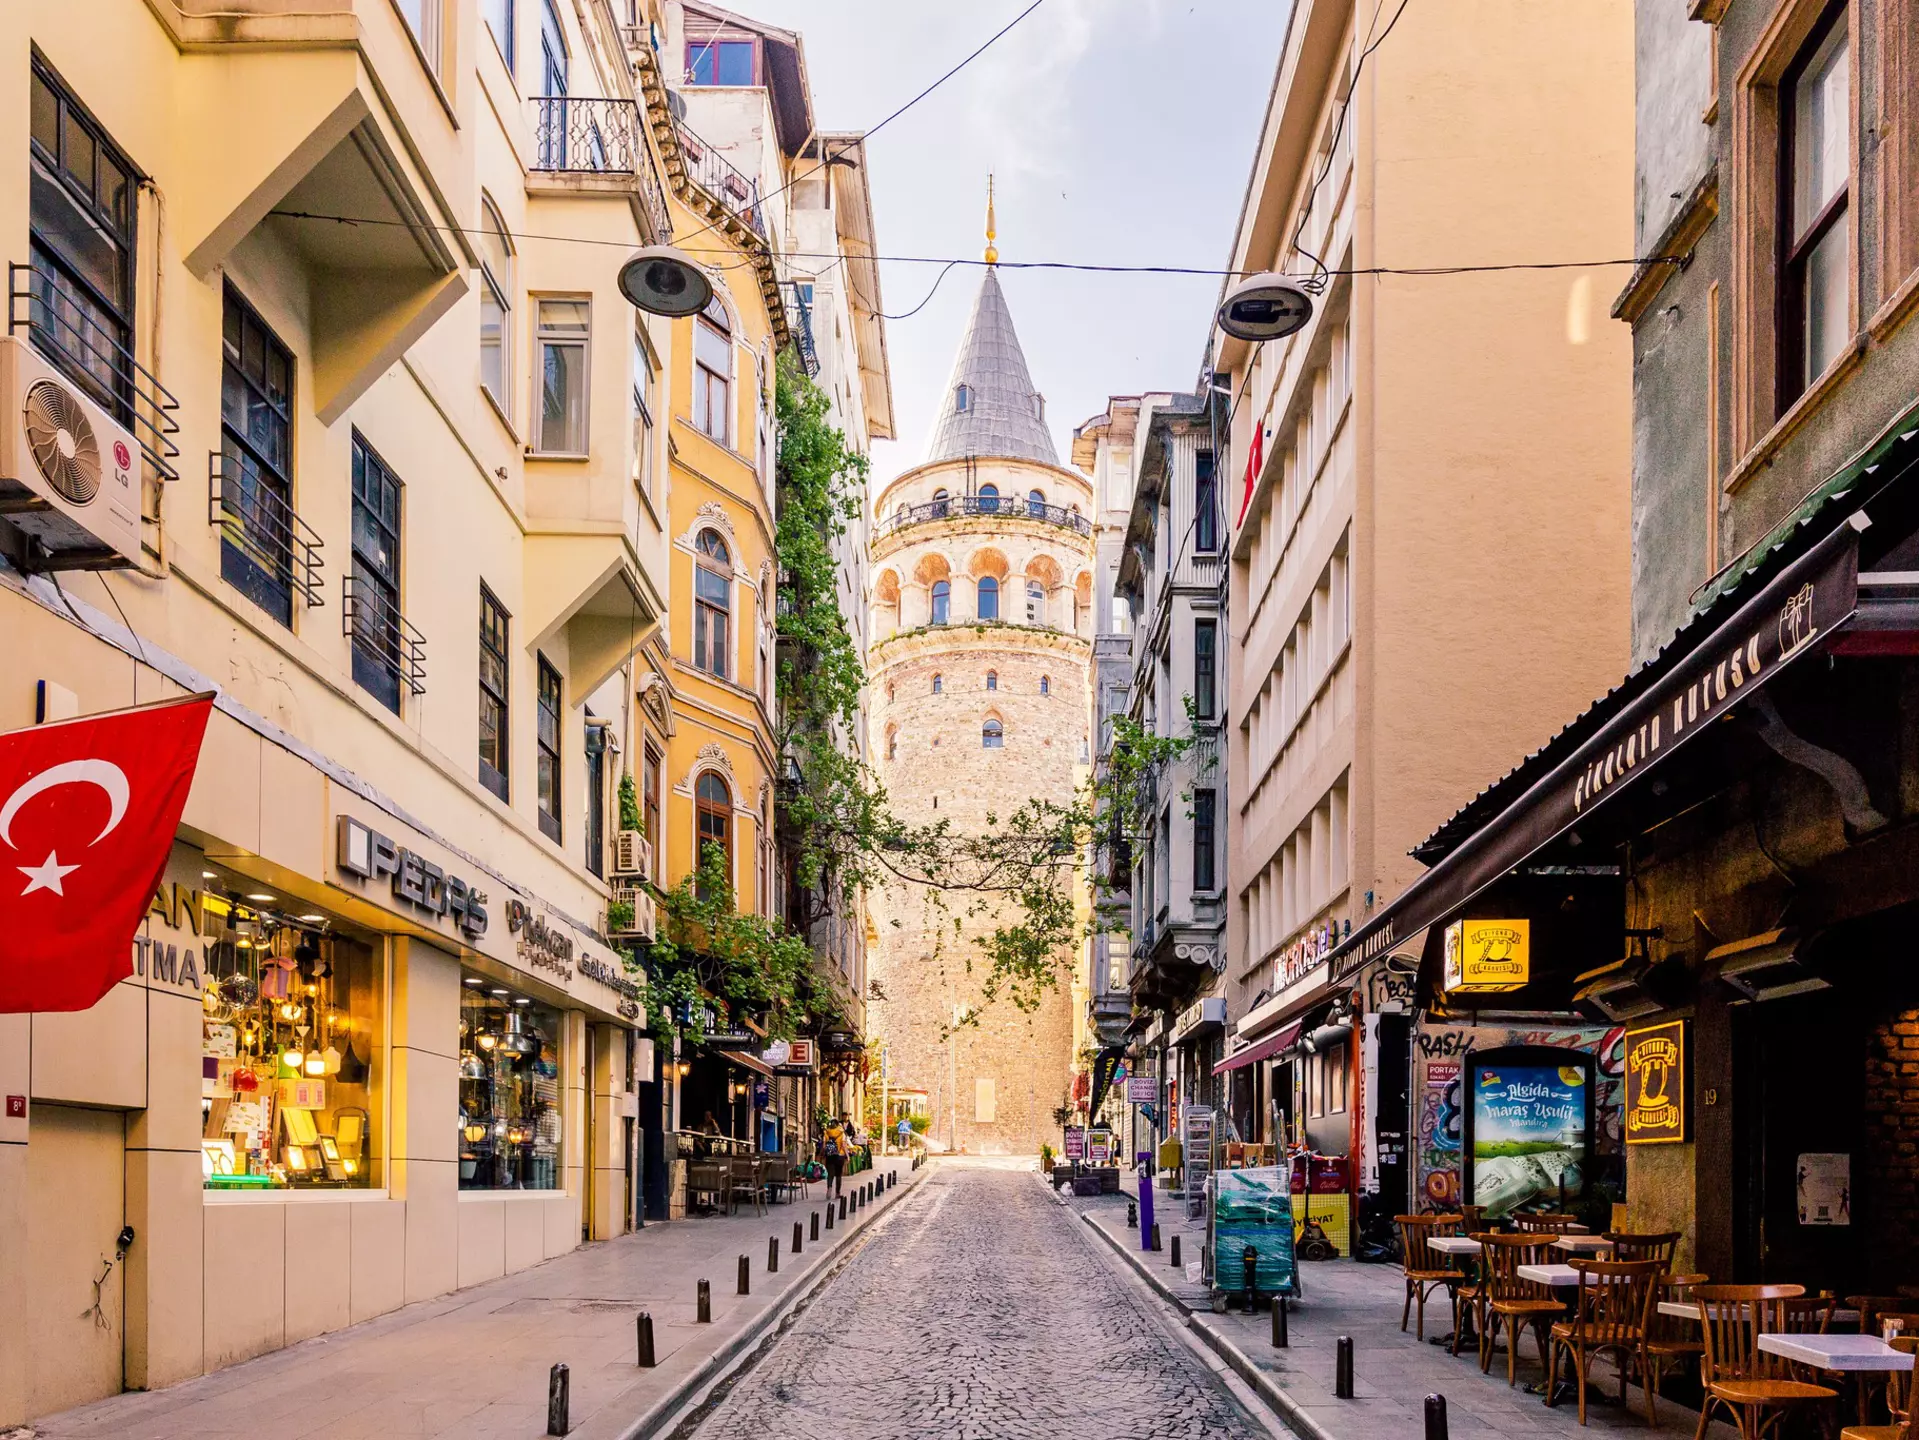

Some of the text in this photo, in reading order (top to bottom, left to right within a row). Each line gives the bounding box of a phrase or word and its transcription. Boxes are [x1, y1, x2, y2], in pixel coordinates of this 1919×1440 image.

[115, 468, 129, 488] LG
[1574, 632, 1761, 812] ÇİKOLATA KUTUSU
[1507, 1082, 1549, 1102] Algida
[1705, 1088, 1717, 1105] 19
